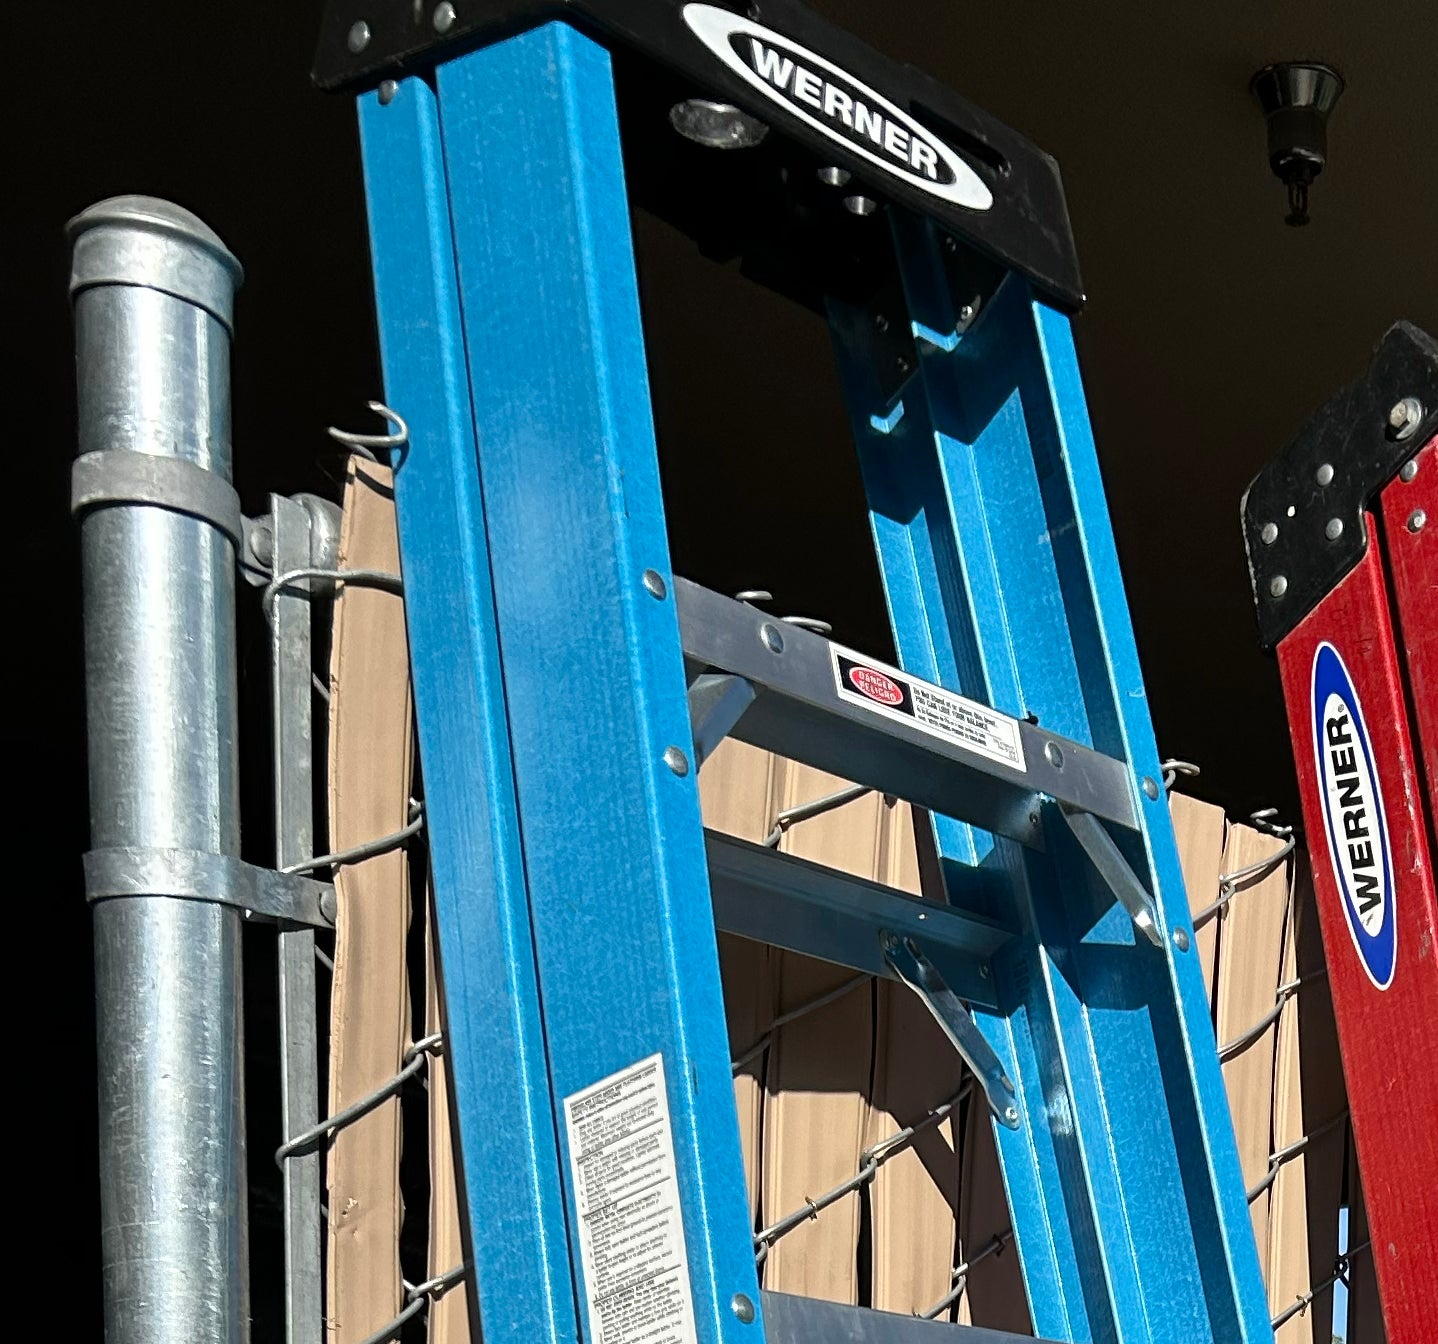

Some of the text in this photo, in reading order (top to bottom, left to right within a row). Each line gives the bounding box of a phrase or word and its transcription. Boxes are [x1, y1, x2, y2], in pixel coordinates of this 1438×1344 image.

[751, 38, 938, 179] WERNER
[858, 670, 893, 690] DANGER
[1326, 713, 1382, 915] WERNER
